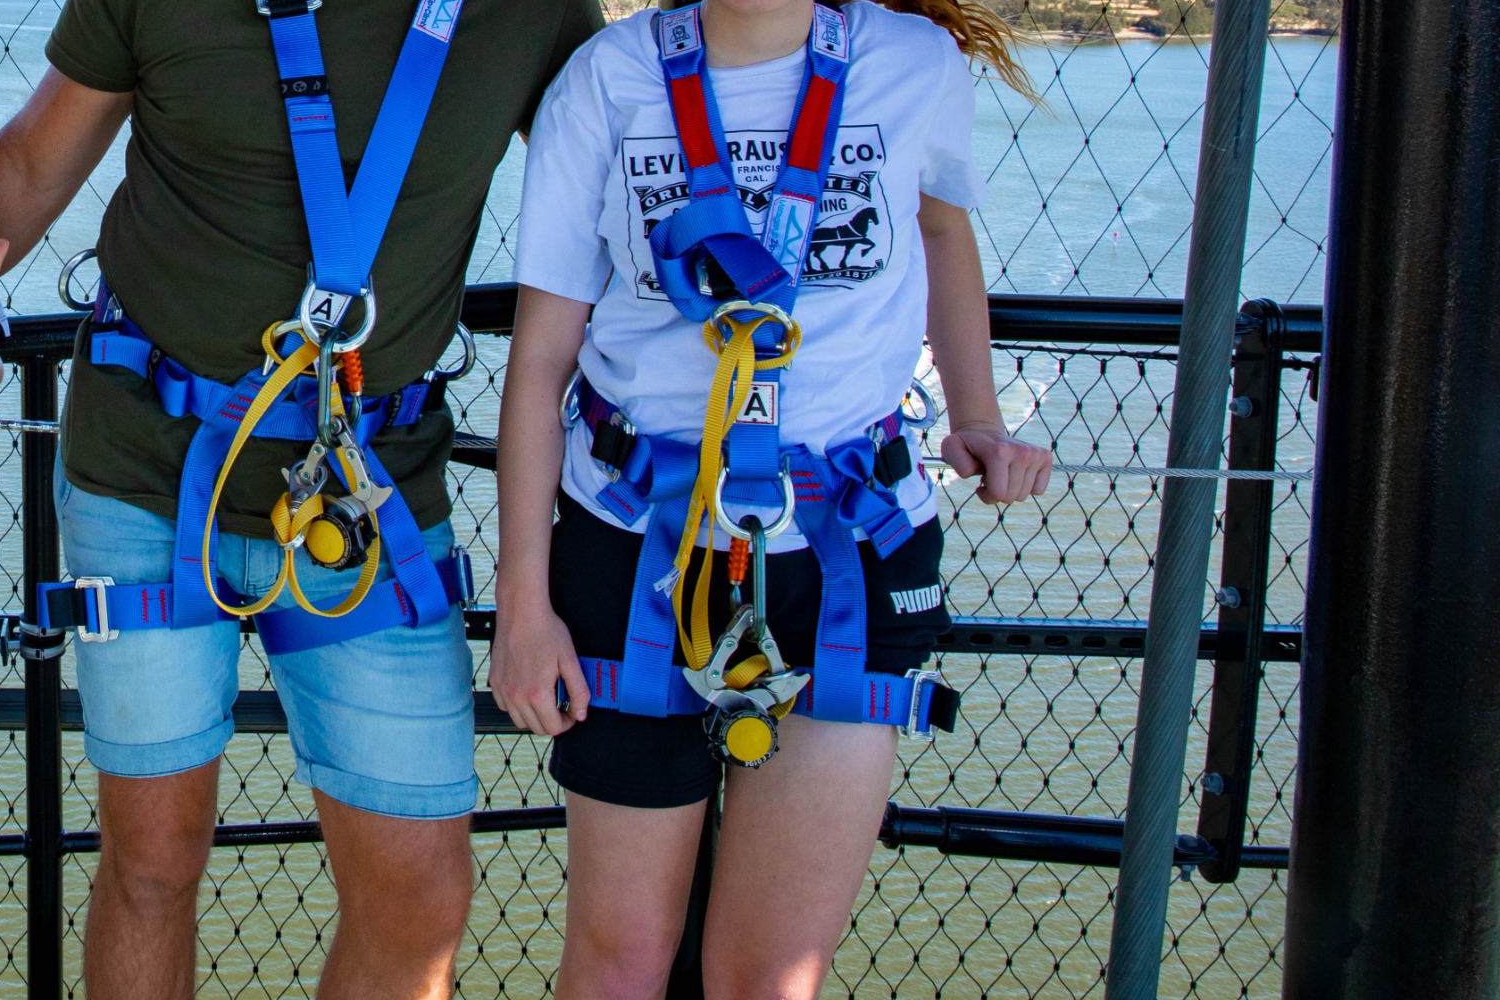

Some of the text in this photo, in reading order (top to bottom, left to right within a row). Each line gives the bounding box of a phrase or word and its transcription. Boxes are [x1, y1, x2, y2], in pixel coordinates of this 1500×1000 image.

[841, 144, 882, 165] CO.
[309, 297, 333, 321] A
[743, 392, 769, 418] A
[890, 584, 941, 615] PUMA
